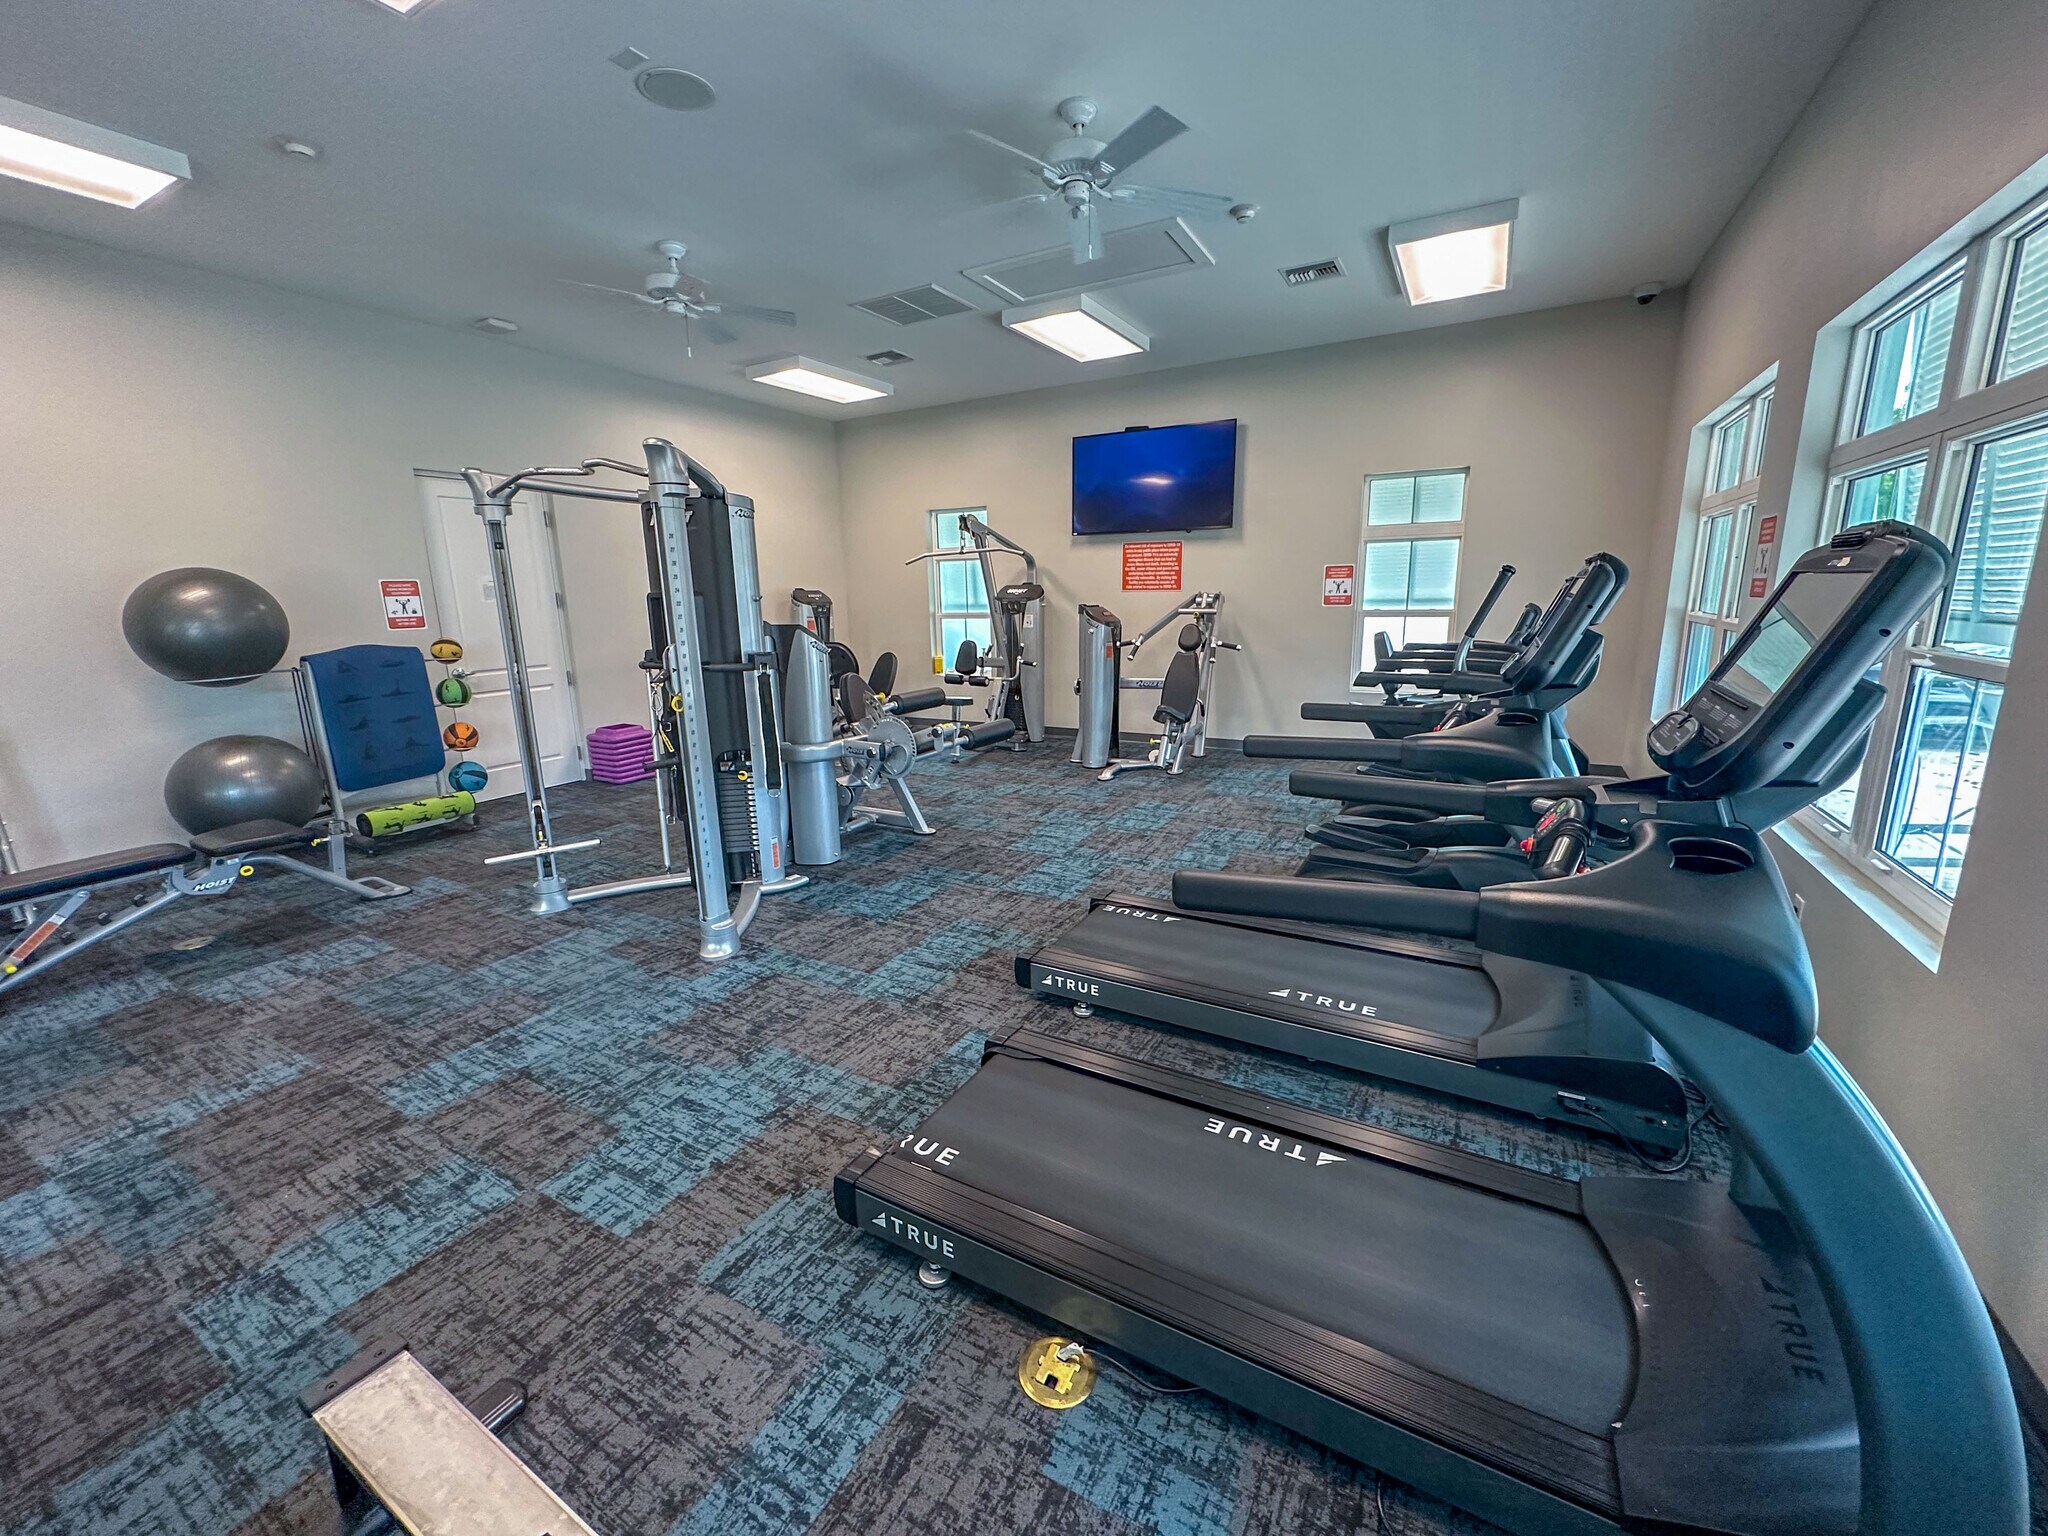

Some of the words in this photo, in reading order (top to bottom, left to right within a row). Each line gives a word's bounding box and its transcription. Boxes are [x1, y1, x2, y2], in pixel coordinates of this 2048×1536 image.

[193, 876, 236, 891] HOIST
[1102, 904, 1159, 921] TRUE
[1054, 974, 1099, 997] TRUE
[1296, 991, 1377, 1017] TRUE
[899, 1134, 960, 1166] RUE
[1203, 1117, 1306, 1163] TRUE
[890, 1216, 955, 1259] TRUE
[1768, 1302, 1826, 1385] TRUE
